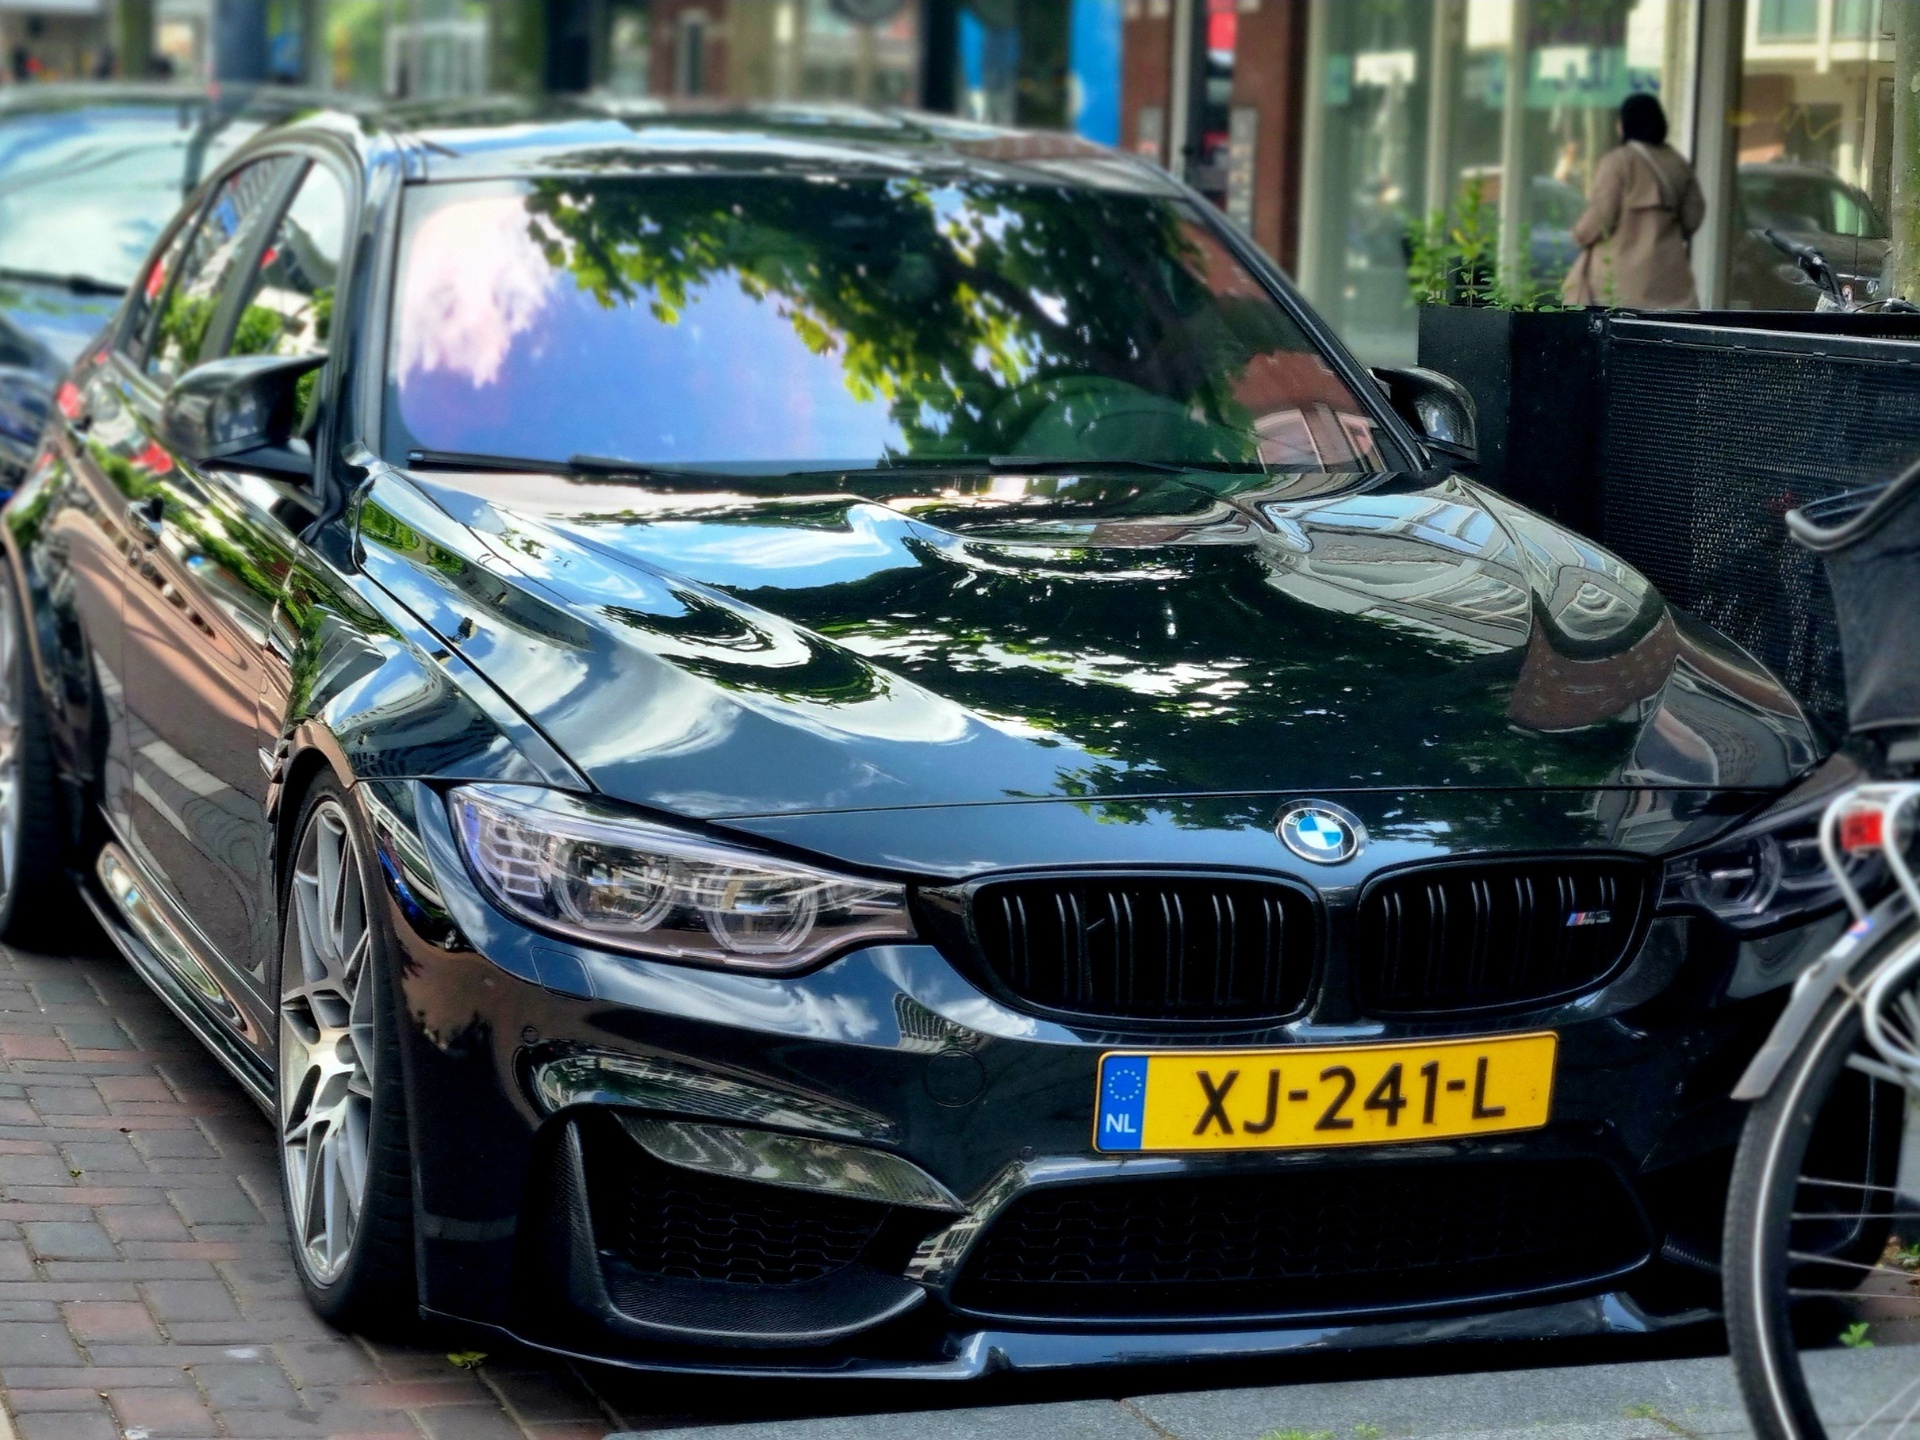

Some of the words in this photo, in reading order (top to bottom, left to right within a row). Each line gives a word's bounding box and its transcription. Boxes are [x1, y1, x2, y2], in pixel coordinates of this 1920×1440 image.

[1285, 808, 1344, 826] BMW
[1193, 1057, 1506, 1135] XJ-241-L
[1105, 1113, 1136, 1133] NL
